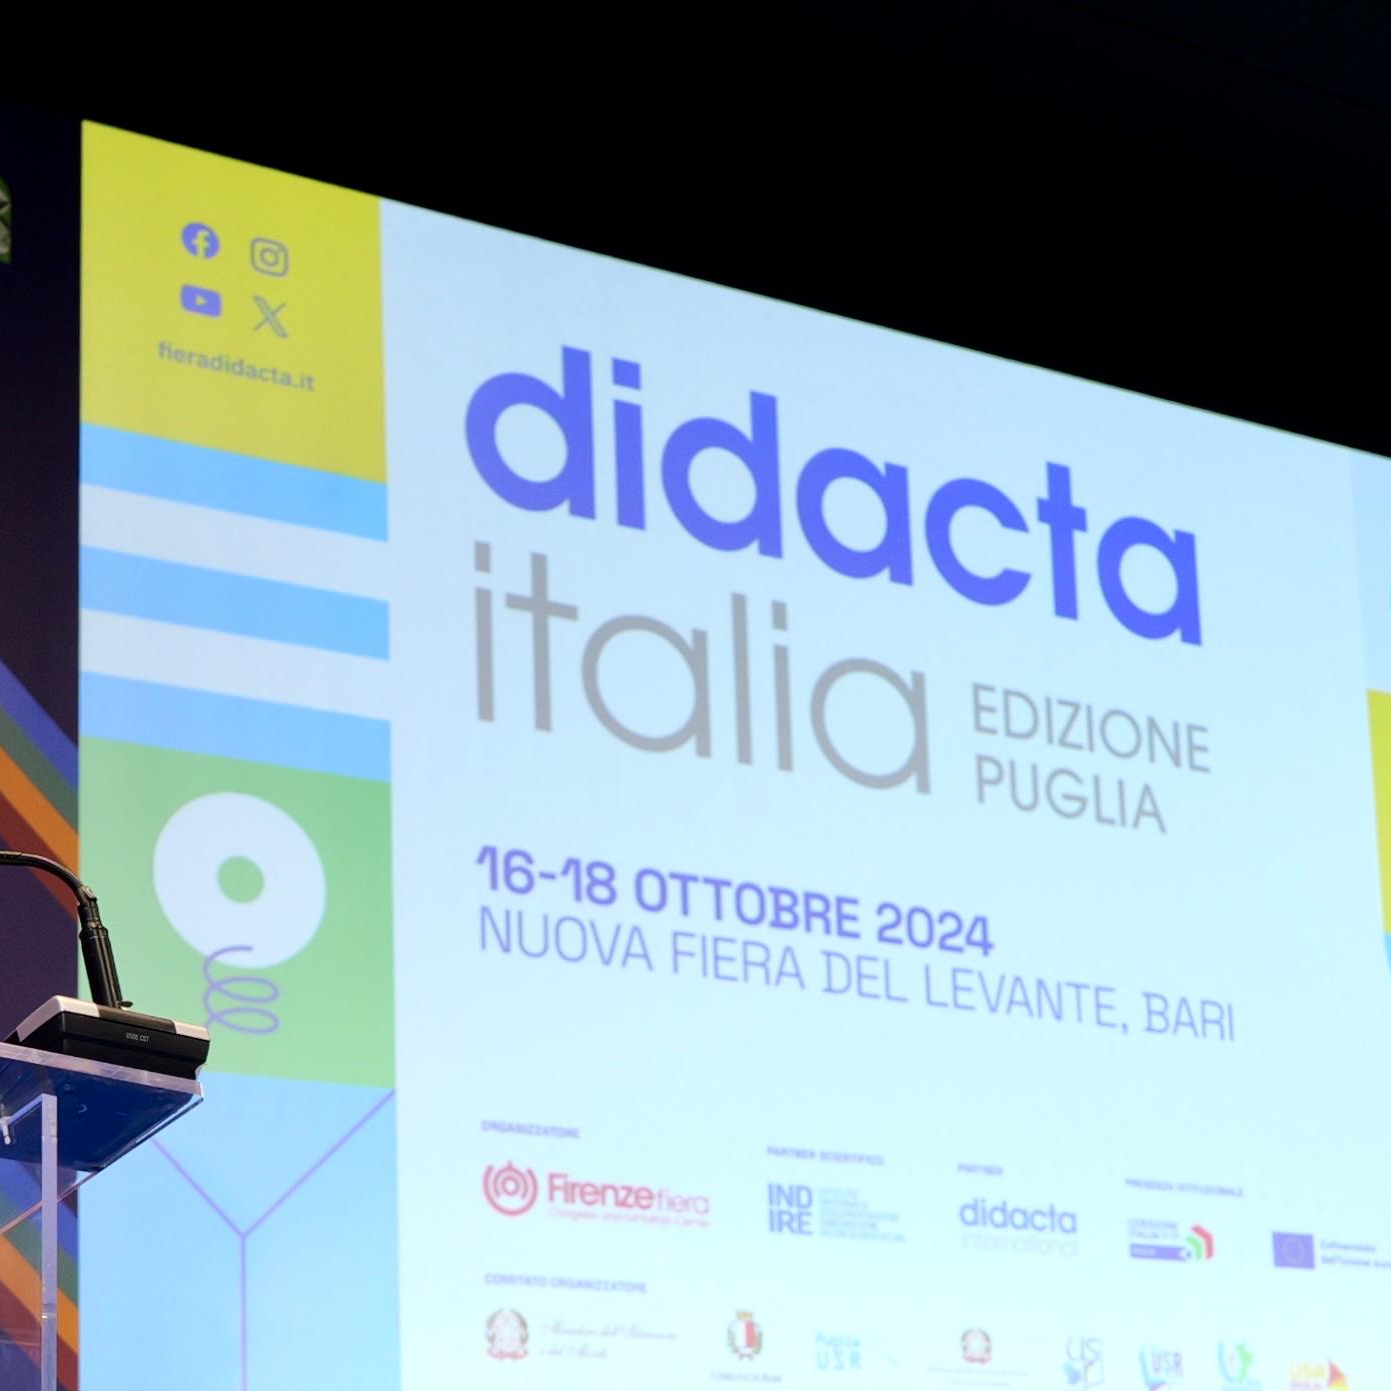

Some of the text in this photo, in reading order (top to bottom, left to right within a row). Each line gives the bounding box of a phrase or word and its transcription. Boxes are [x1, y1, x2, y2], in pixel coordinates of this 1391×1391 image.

[158, 340, 315, 391] fieradidacta.it
[465, 345, 1203, 646] didacta
[473, 540, 931, 795] italia
[971, 683, 1211, 772] EDIZIONE
[975, 754, 1167, 833] PUGLIA
[476, 845, 994, 957] 16-18 OTTOBRE 2024
[479, 907, 1235, 1041] NUOVA FIERA DEL LEVANTE, BARI
[959, 1198, 1077, 1234] didacta
